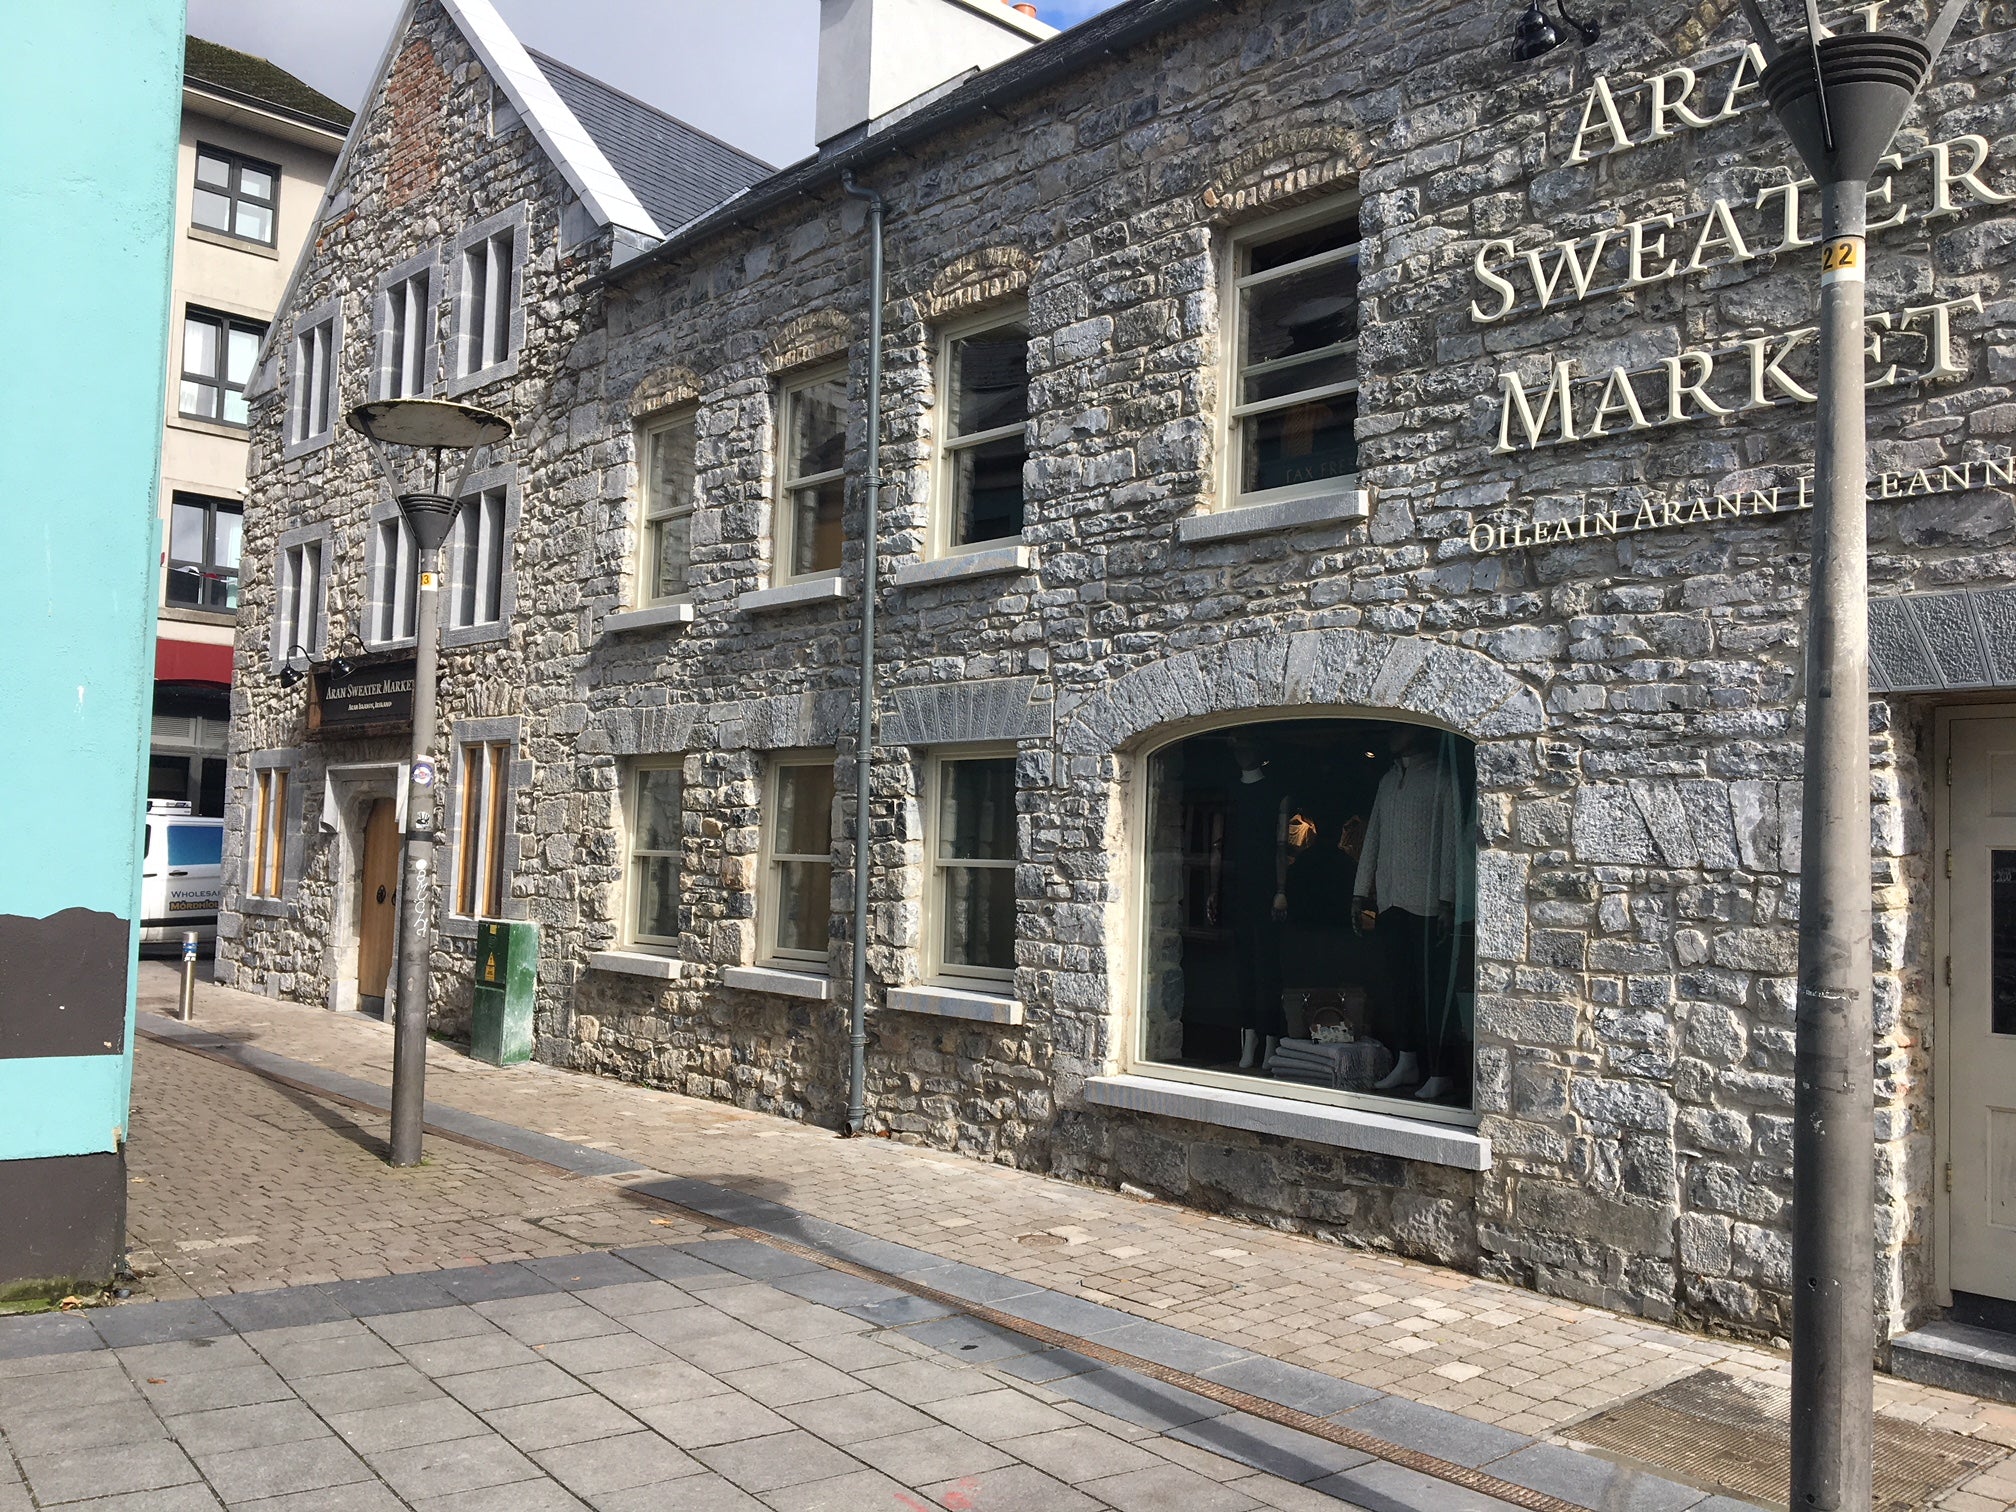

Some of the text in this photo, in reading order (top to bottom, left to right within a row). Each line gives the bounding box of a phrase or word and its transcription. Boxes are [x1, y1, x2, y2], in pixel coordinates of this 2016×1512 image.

[1823, 243, 1853, 271] 22
[326, 686, 346, 700] ARAN
[347, 684, 383, 698] SWEATER
